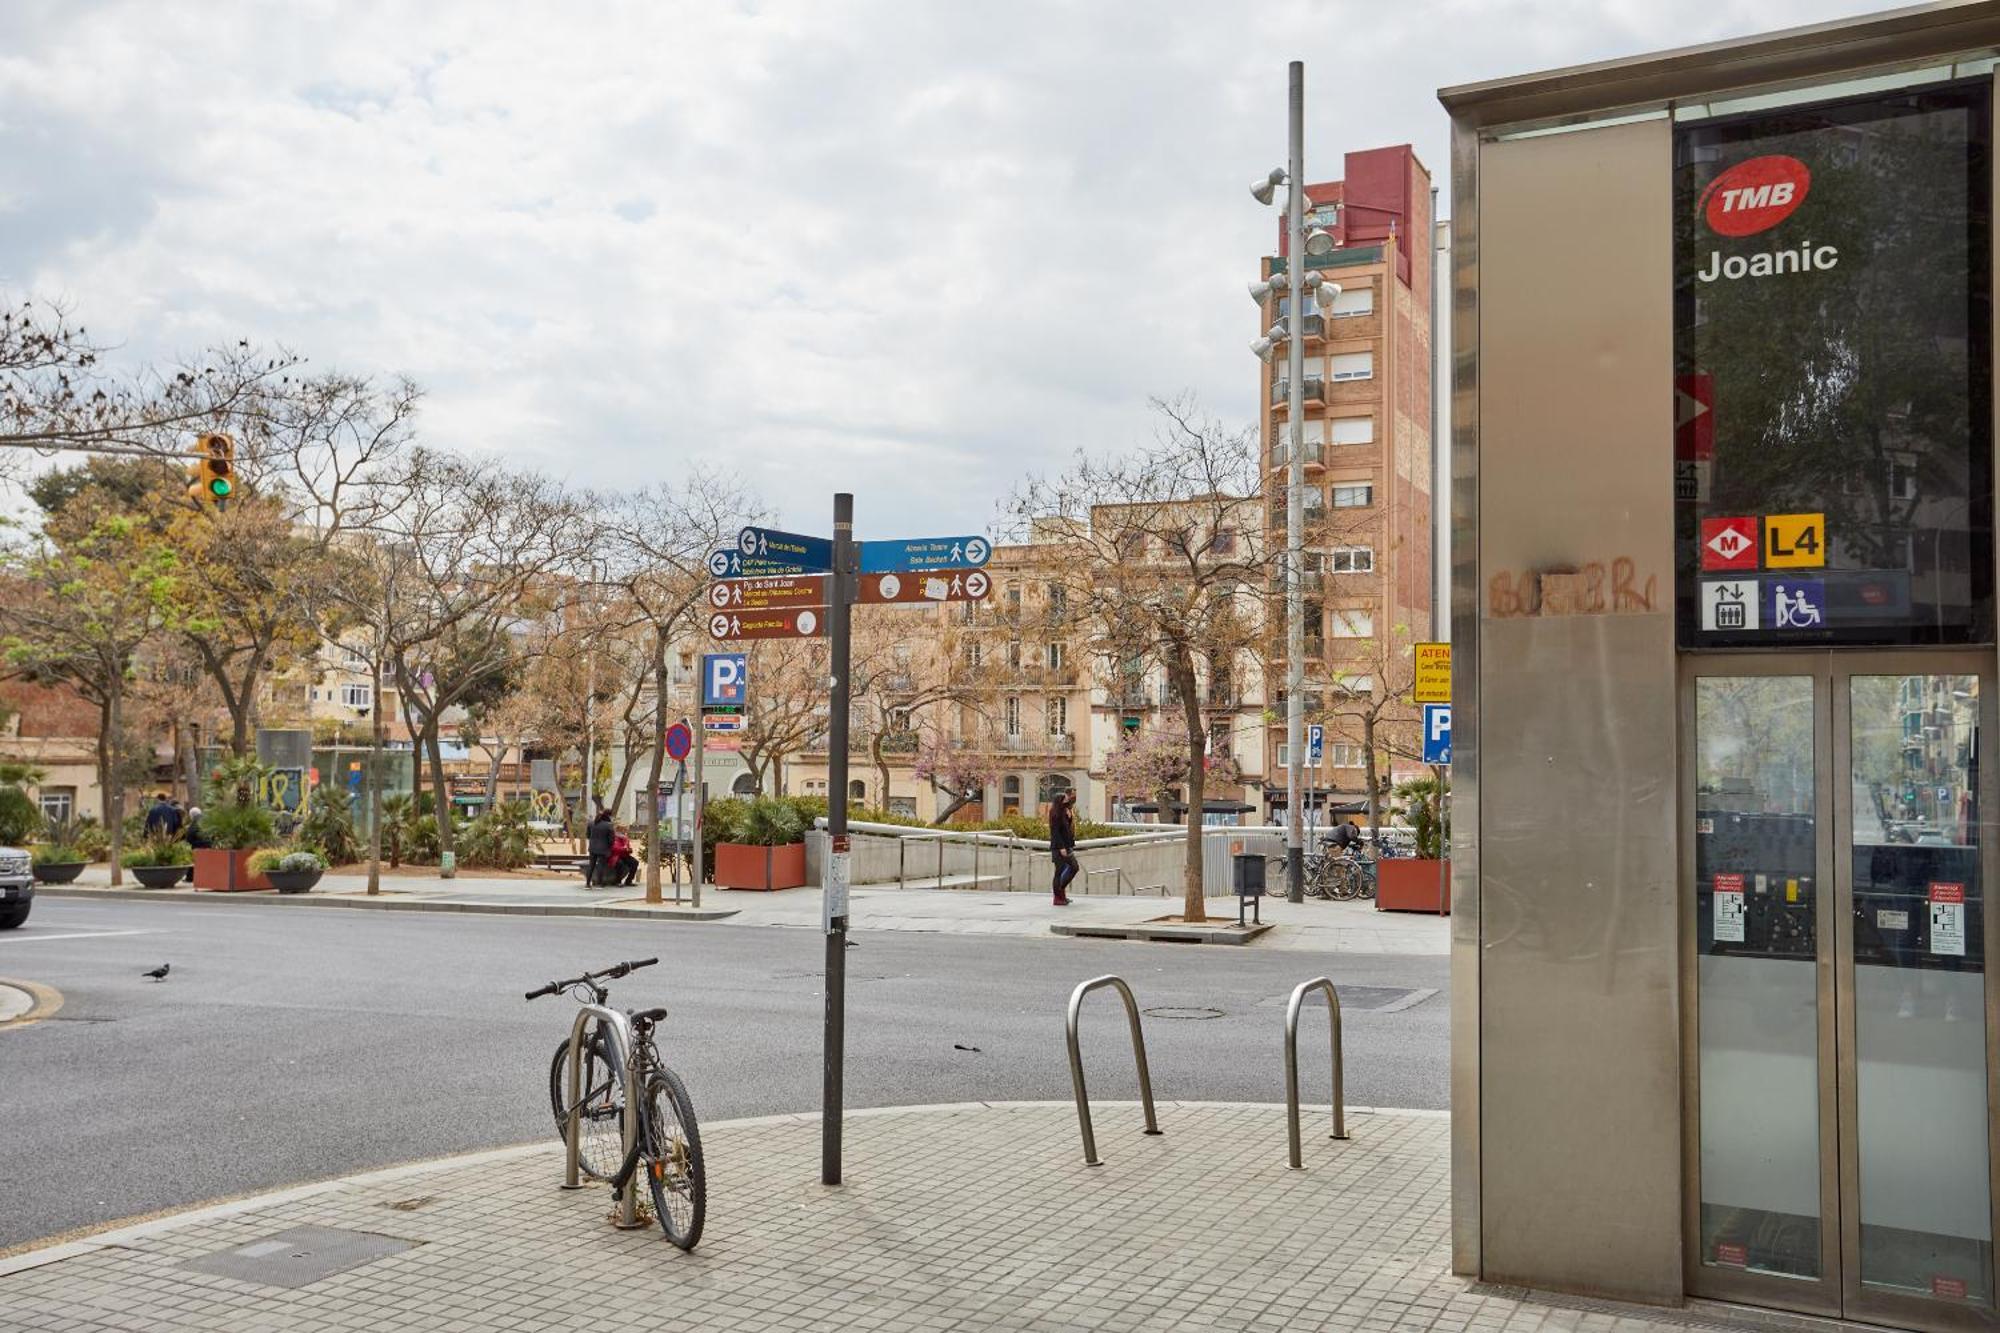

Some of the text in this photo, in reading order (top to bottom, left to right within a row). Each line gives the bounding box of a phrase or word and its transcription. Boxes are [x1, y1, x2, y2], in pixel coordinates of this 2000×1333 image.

[1722, 182, 1796, 213] TMB
[1698, 240, 1838, 283] Joanic
[1720, 536, 1739, 552] M
[1770, 526, 1819, 556] L4
[764, 580, 778, 589] Sant
[779, 580, 795, 588] Joan
[713, 659, 737, 698] P
[1312, 728, 1321, 745] P
[1431, 709, 1451, 741] P
